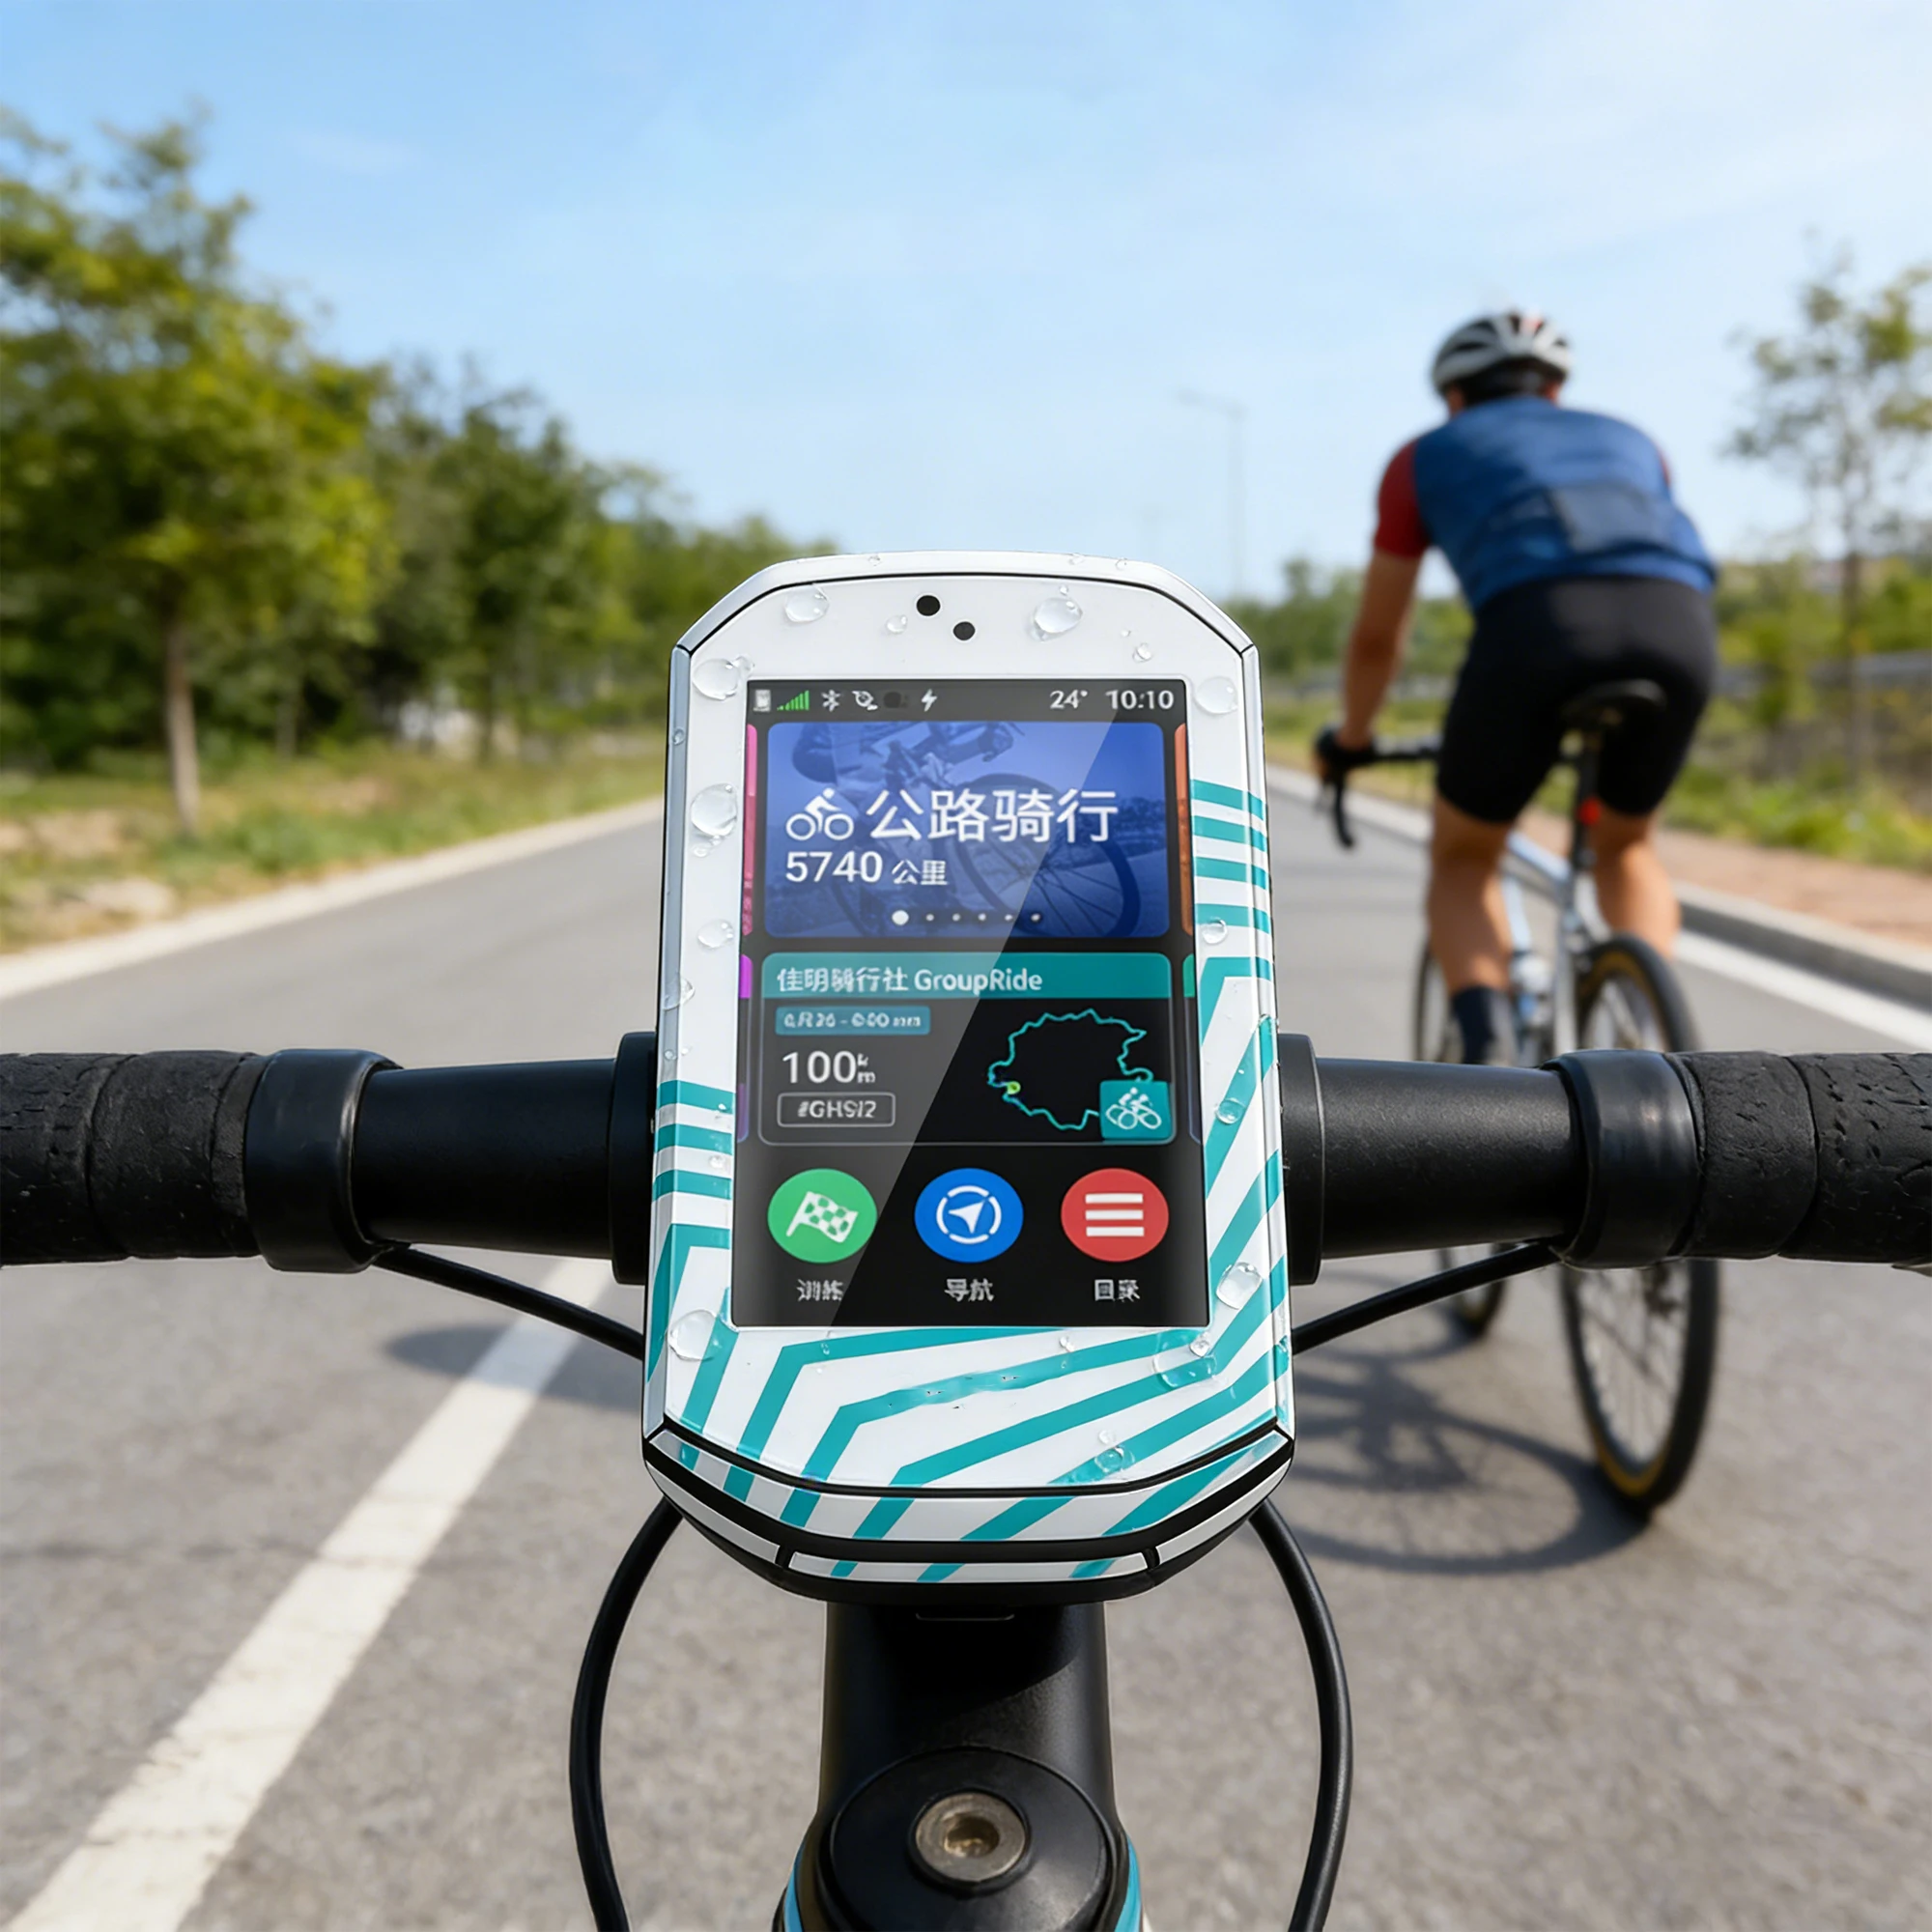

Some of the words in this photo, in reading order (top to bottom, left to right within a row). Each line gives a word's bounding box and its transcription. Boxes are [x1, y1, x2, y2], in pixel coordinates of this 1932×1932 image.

[1049, 690, 1088, 709] 24°
[1105, 690, 1175, 710] 10:10
[866, 787, 1120, 843] 公路骑行
[784, 851, 883, 883] 5740
[891, 860, 949, 886] 公里
[914, 968, 1043, 996] GroupRide
